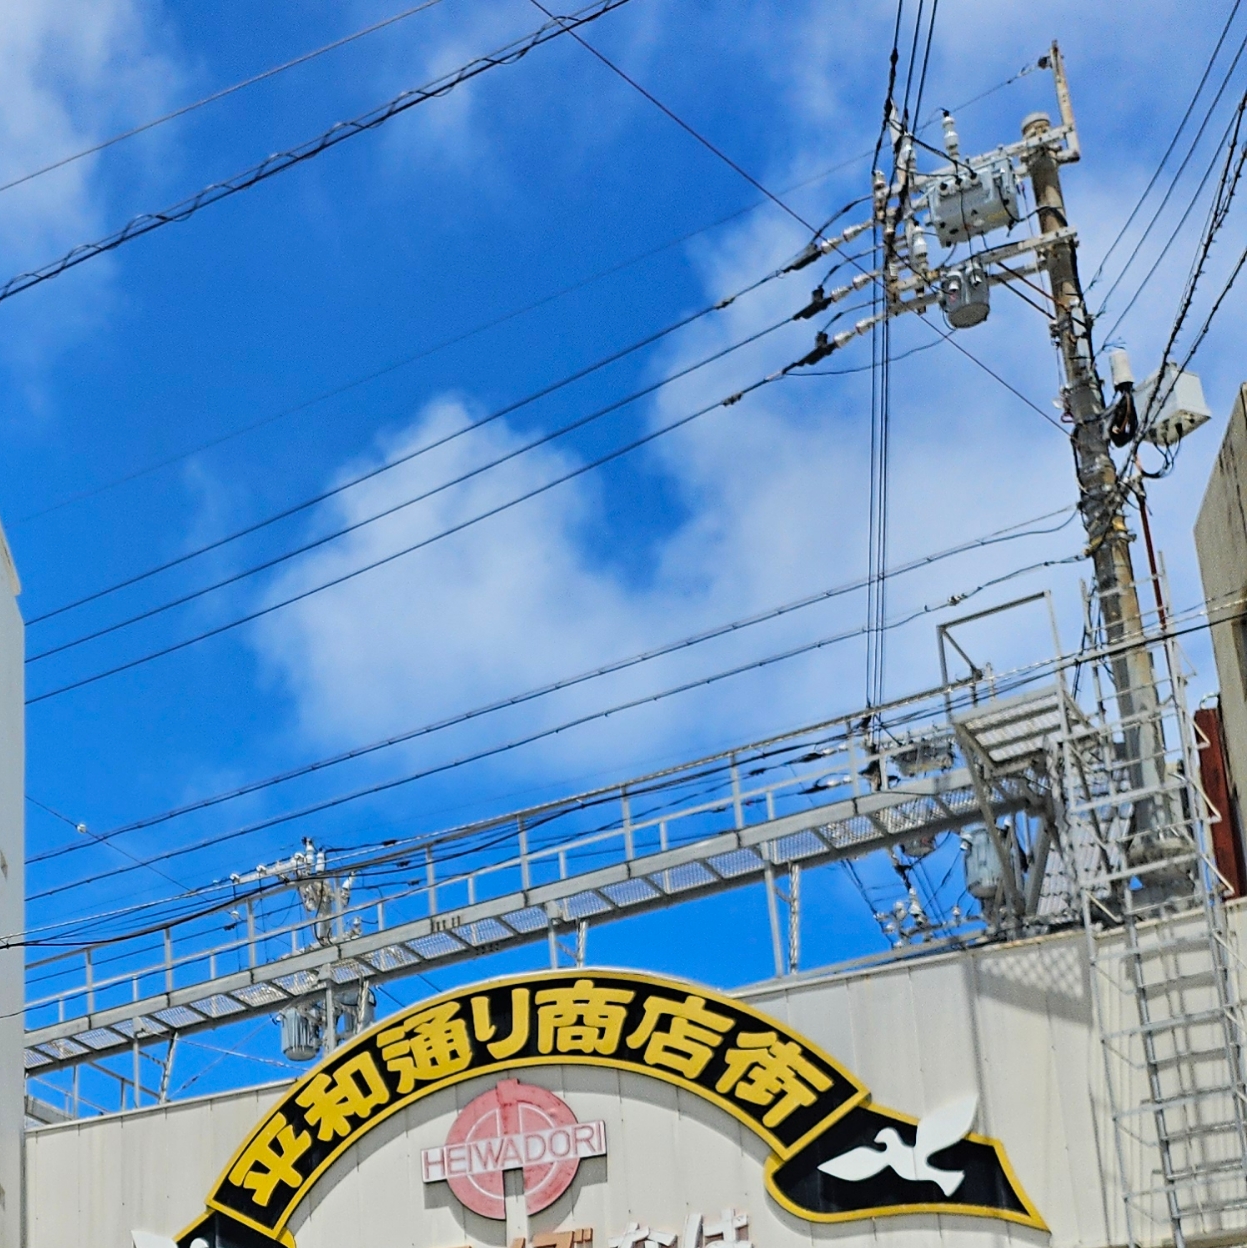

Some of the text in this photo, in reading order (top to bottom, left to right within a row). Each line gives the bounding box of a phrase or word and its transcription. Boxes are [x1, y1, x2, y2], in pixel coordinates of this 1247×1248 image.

[229, 979, 835, 1207] 平和通り商店街
[423, 1124, 603, 1180] HEIWADORI
